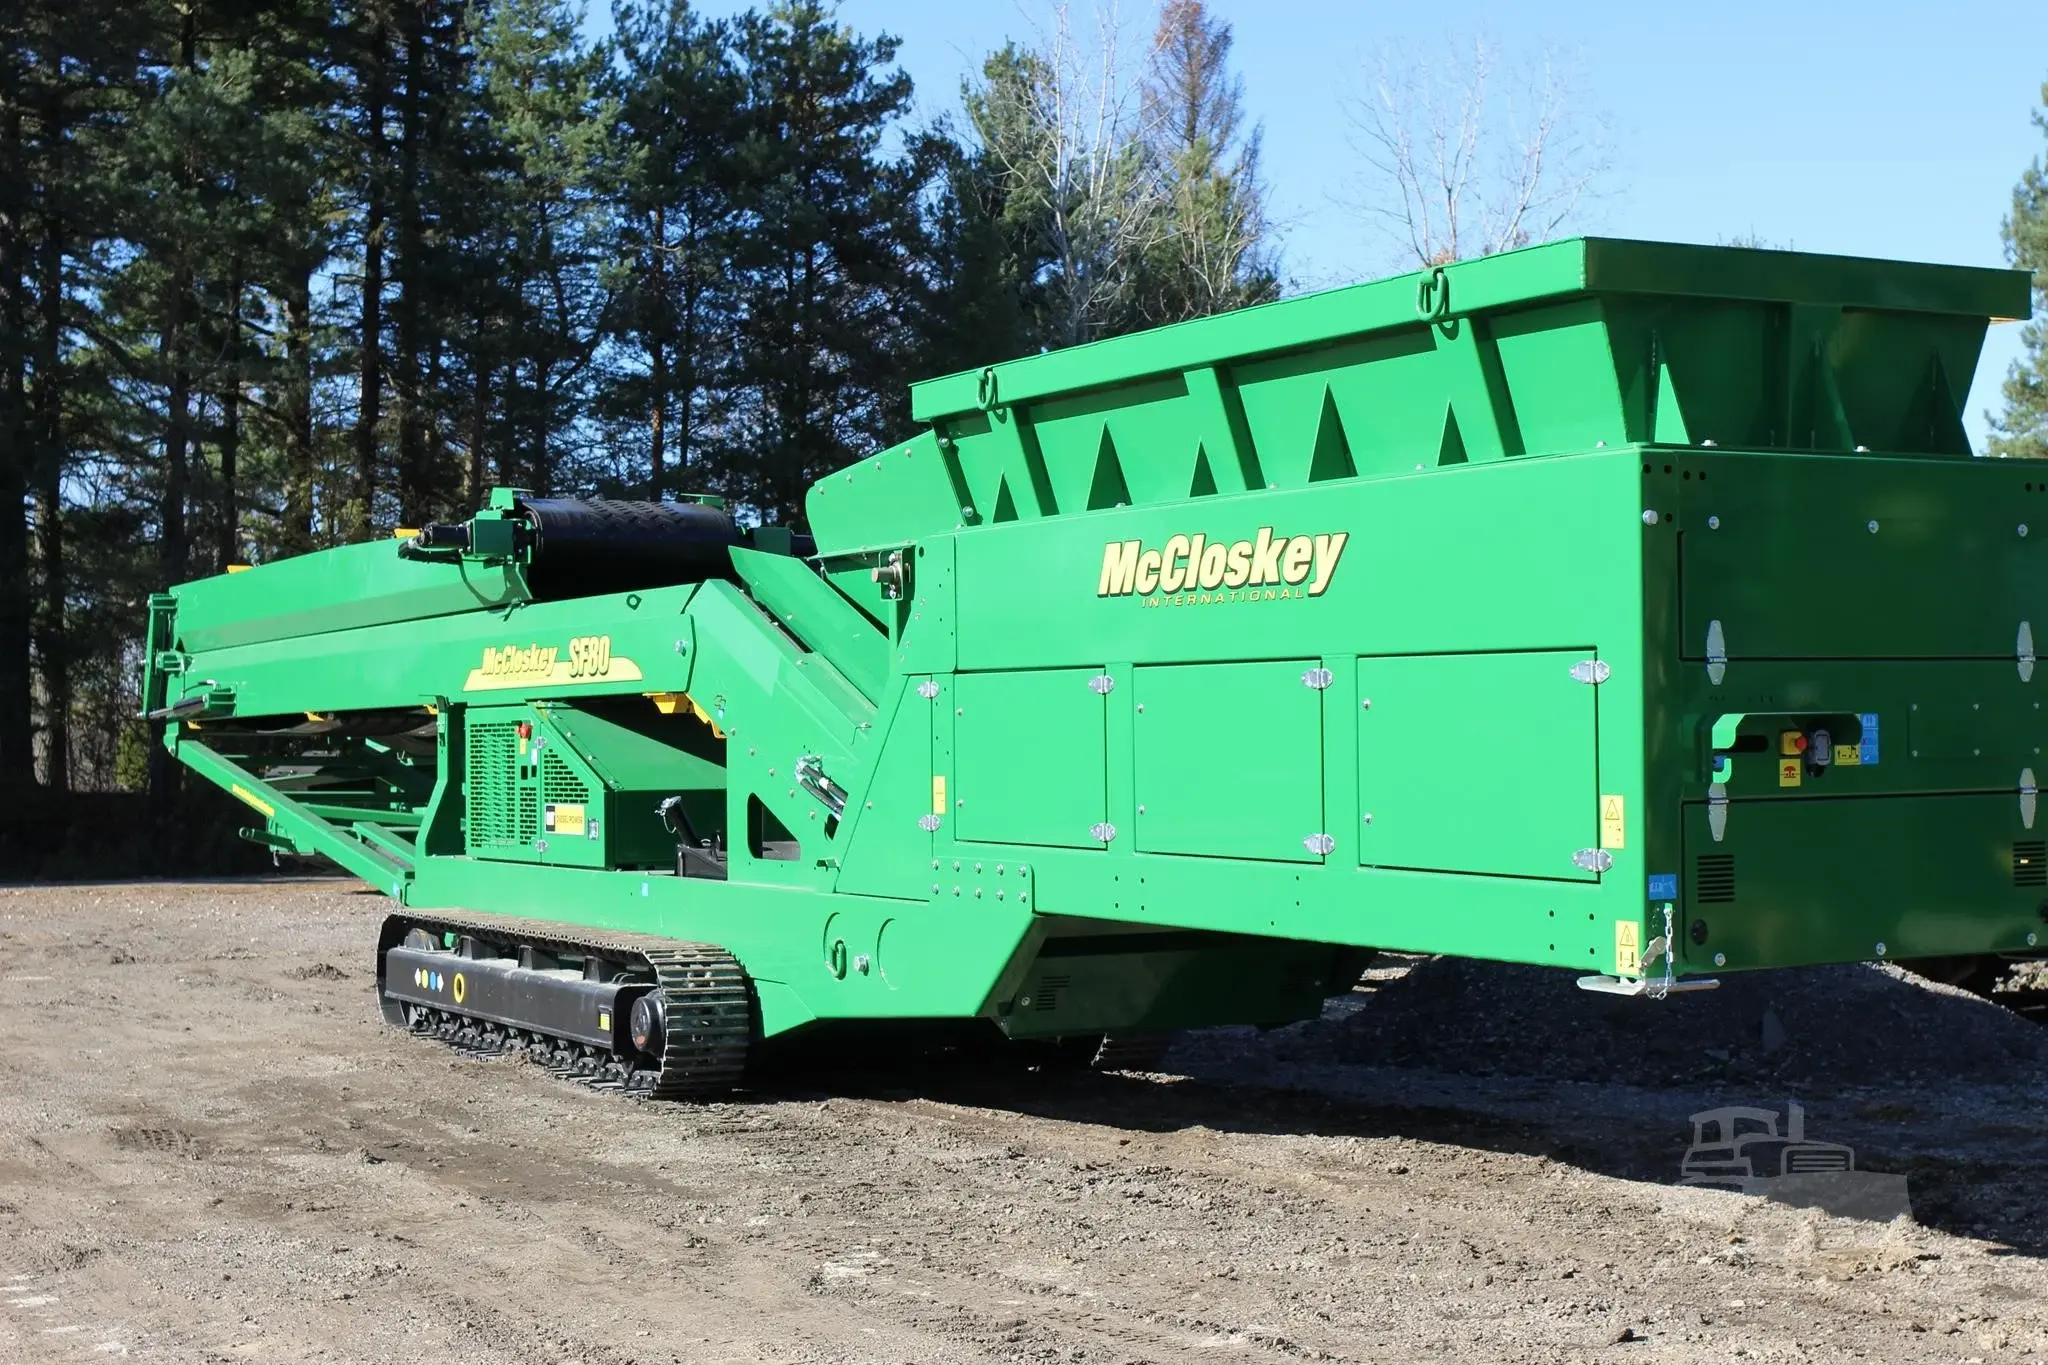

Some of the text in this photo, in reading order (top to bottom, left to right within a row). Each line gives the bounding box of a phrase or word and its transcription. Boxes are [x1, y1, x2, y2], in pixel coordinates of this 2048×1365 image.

[1097, 526, 1350, 597] McCloskey
[1141, 588, 1304, 608] INTERNATIONAL
[481, 635, 611, 678] McCloskey SF80
